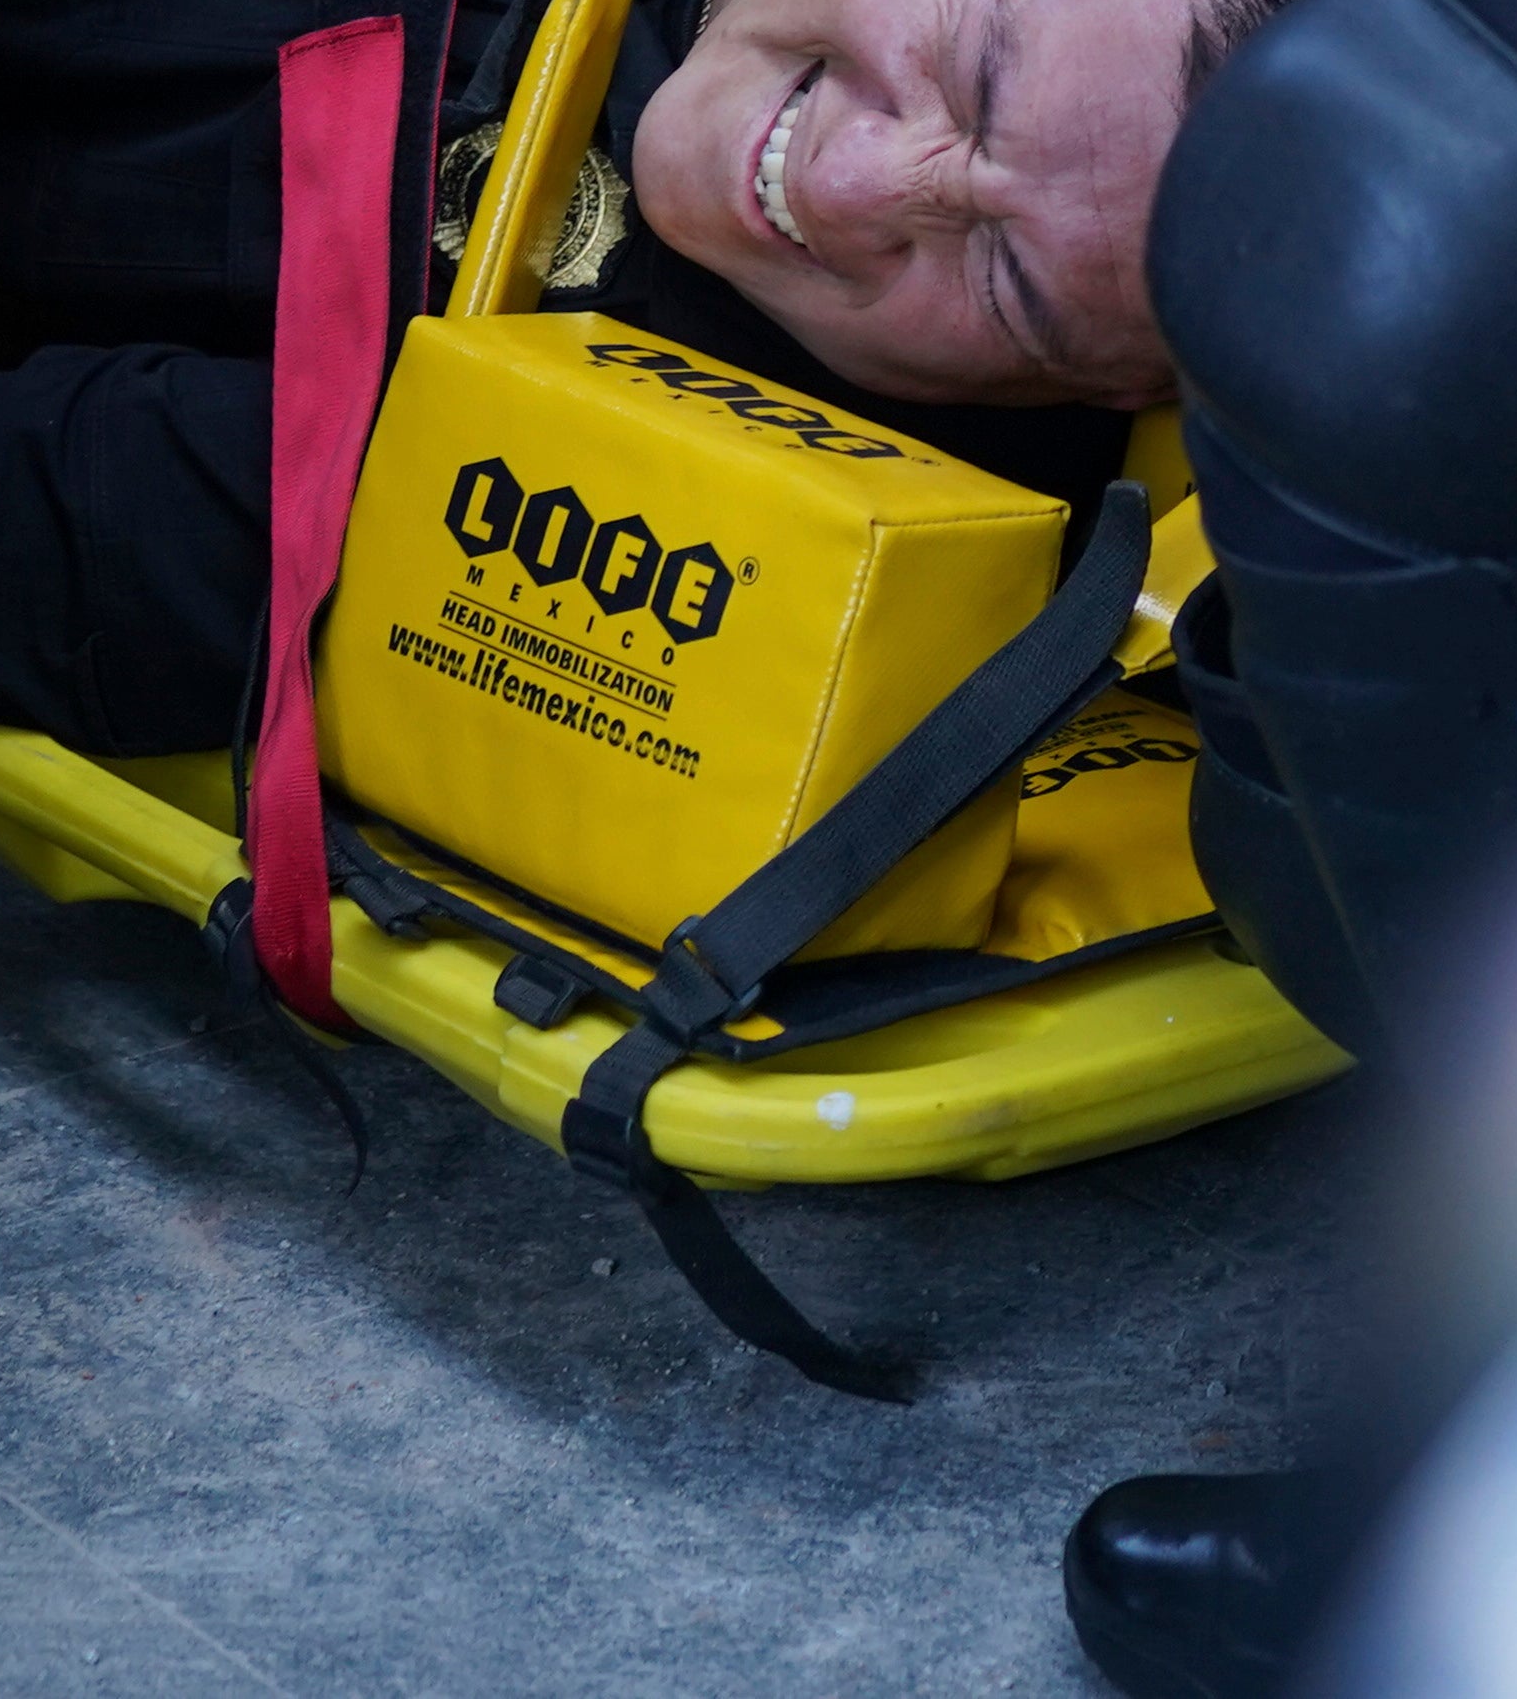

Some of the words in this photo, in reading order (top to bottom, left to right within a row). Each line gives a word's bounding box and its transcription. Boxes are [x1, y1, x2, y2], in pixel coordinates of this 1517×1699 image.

[585, 344, 905, 459] LIFE
[444, 457, 735, 645] LIFE
[440, 598, 496, 638] HEAD
[500, 623, 675, 713] IMMOBILIZATION
[466, 564, 675, 667] MEXICO
[387, 623, 701, 779] www.lifemexico.com
[1020, 738, 1200, 800] LIF
